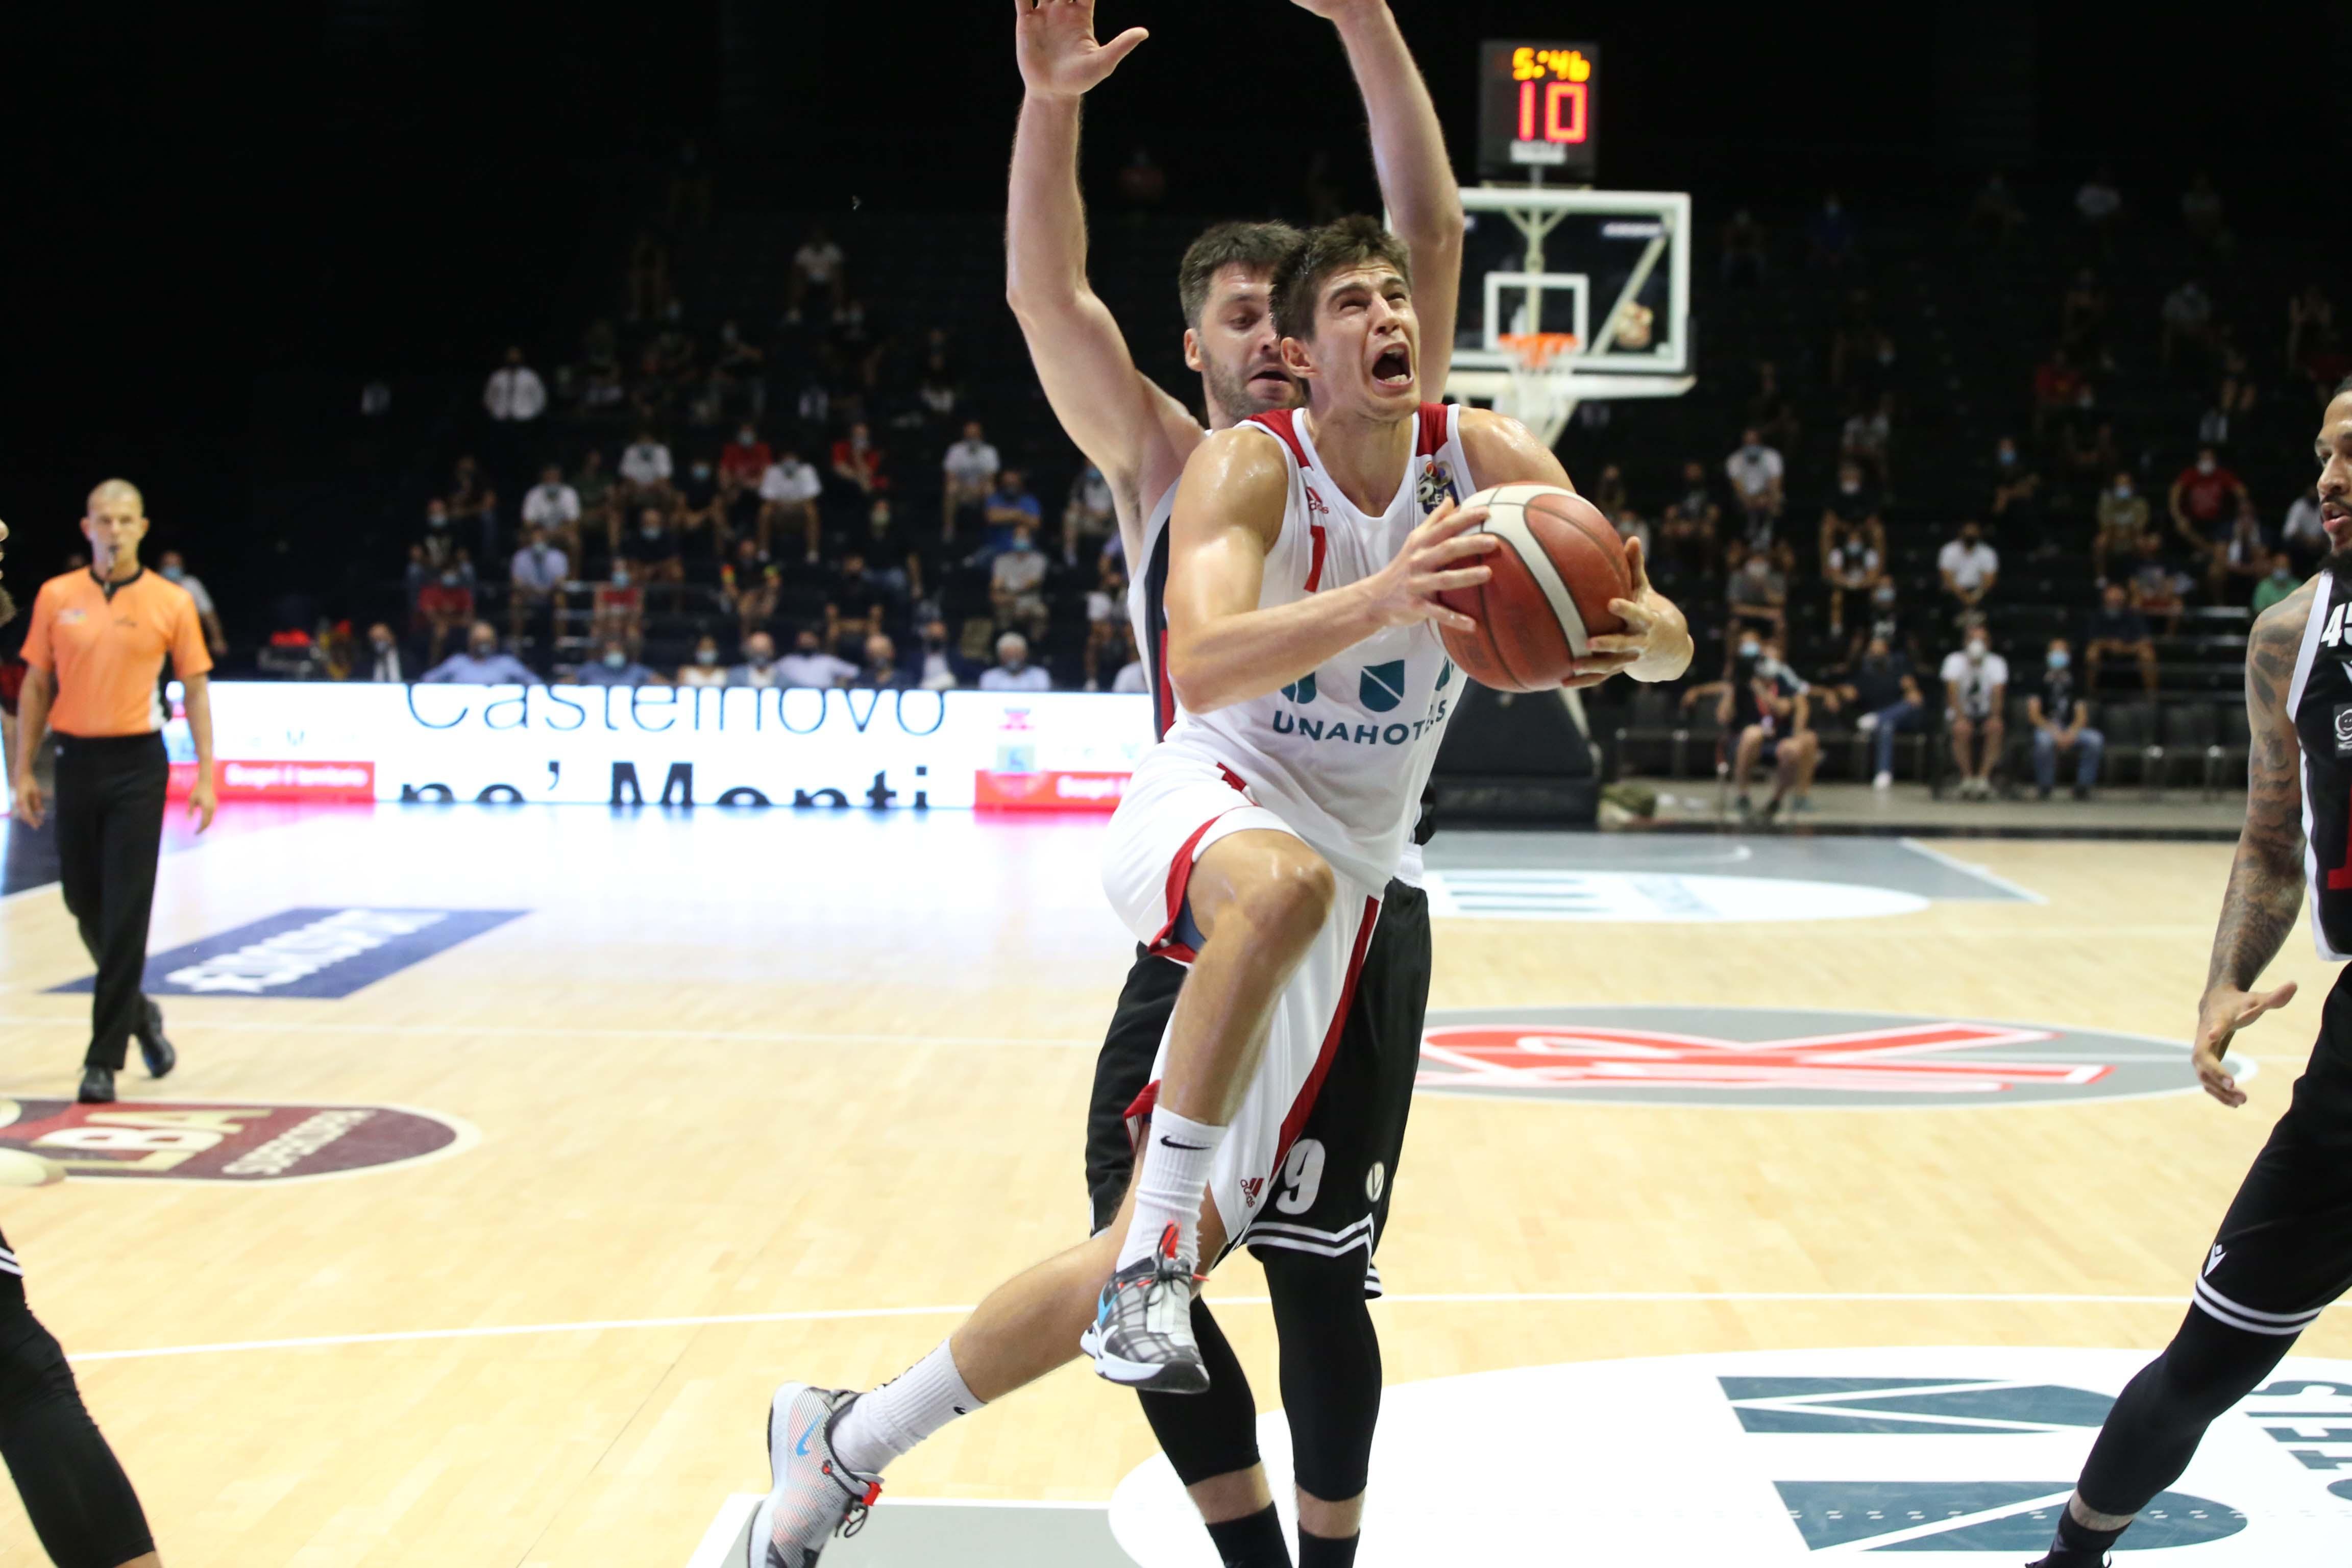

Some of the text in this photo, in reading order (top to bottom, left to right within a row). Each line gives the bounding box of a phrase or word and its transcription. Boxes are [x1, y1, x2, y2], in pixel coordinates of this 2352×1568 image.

[1513, 47, 1590, 82] 5:46
[1519, 80, 1587, 143] 10
[1276, 1138, 1326, 1215] 9
